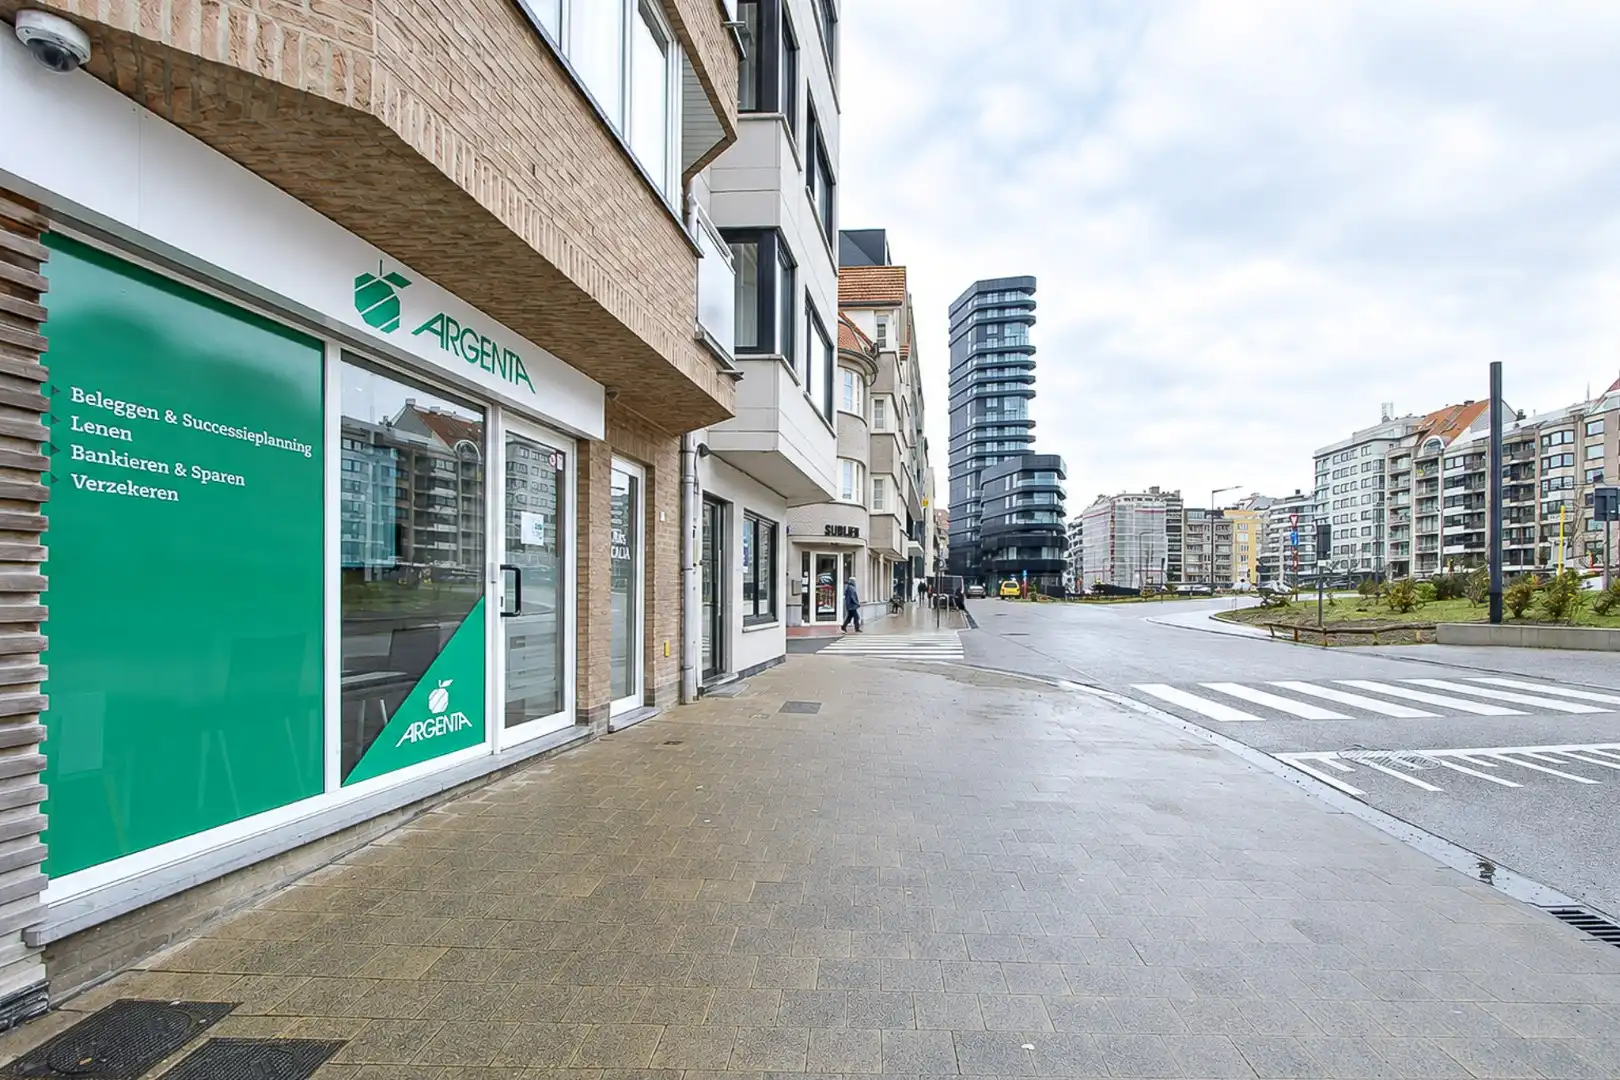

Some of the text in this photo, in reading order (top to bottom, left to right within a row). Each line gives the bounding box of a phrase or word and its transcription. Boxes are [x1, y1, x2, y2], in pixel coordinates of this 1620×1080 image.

[411, 312, 536, 394] ARGENTA
[71, 386, 312, 458] Beleggen & Successieplanning
[71, 415, 133, 442] Lenen
[71, 444, 246, 487] Bankieren & Sparen
[71, 473, 179, 502] Verzekeren
[395, 711, 473, 748] ARGENTA
